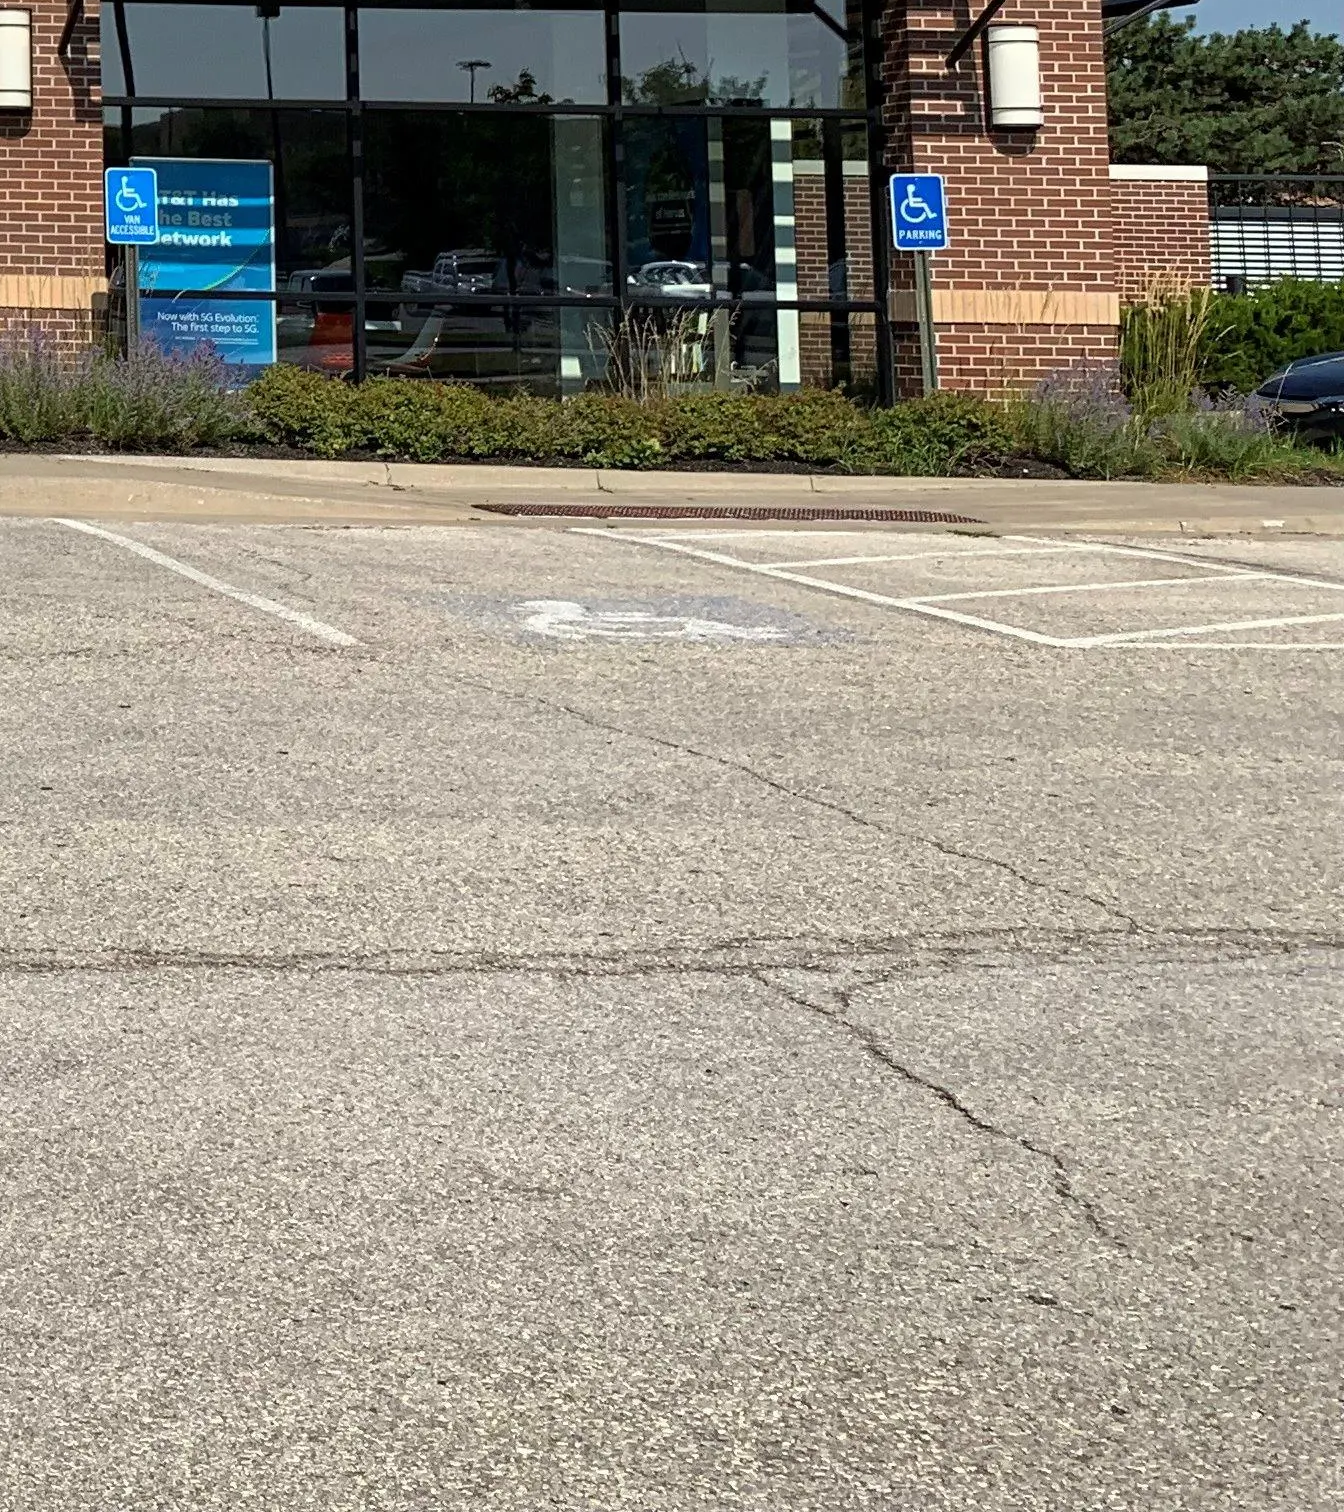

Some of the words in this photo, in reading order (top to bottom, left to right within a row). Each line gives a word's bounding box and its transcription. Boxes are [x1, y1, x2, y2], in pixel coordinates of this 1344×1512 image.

[157, 190, 197, 207] T&T
[202, 190, 239, 207] Has
[123, 215, 141, 225] VAN
[158, 209, 182, 226] he
[188, 211, 232, 227] Best
[110, 225, 155, 236] ACCESSIBLE
[899, 229, 942, 240] PARKING
[158, 230, 232, 247] etwork
[157, 311, 177, 321] Now
[179, 312, 199, 321] with
[200, 313, 213, 322] 5G
[171, 322, 188, 332] The
[190, 322, 208, 332] first
[210, 324, 230, 334] step
[232, 324, 242, 333] to
